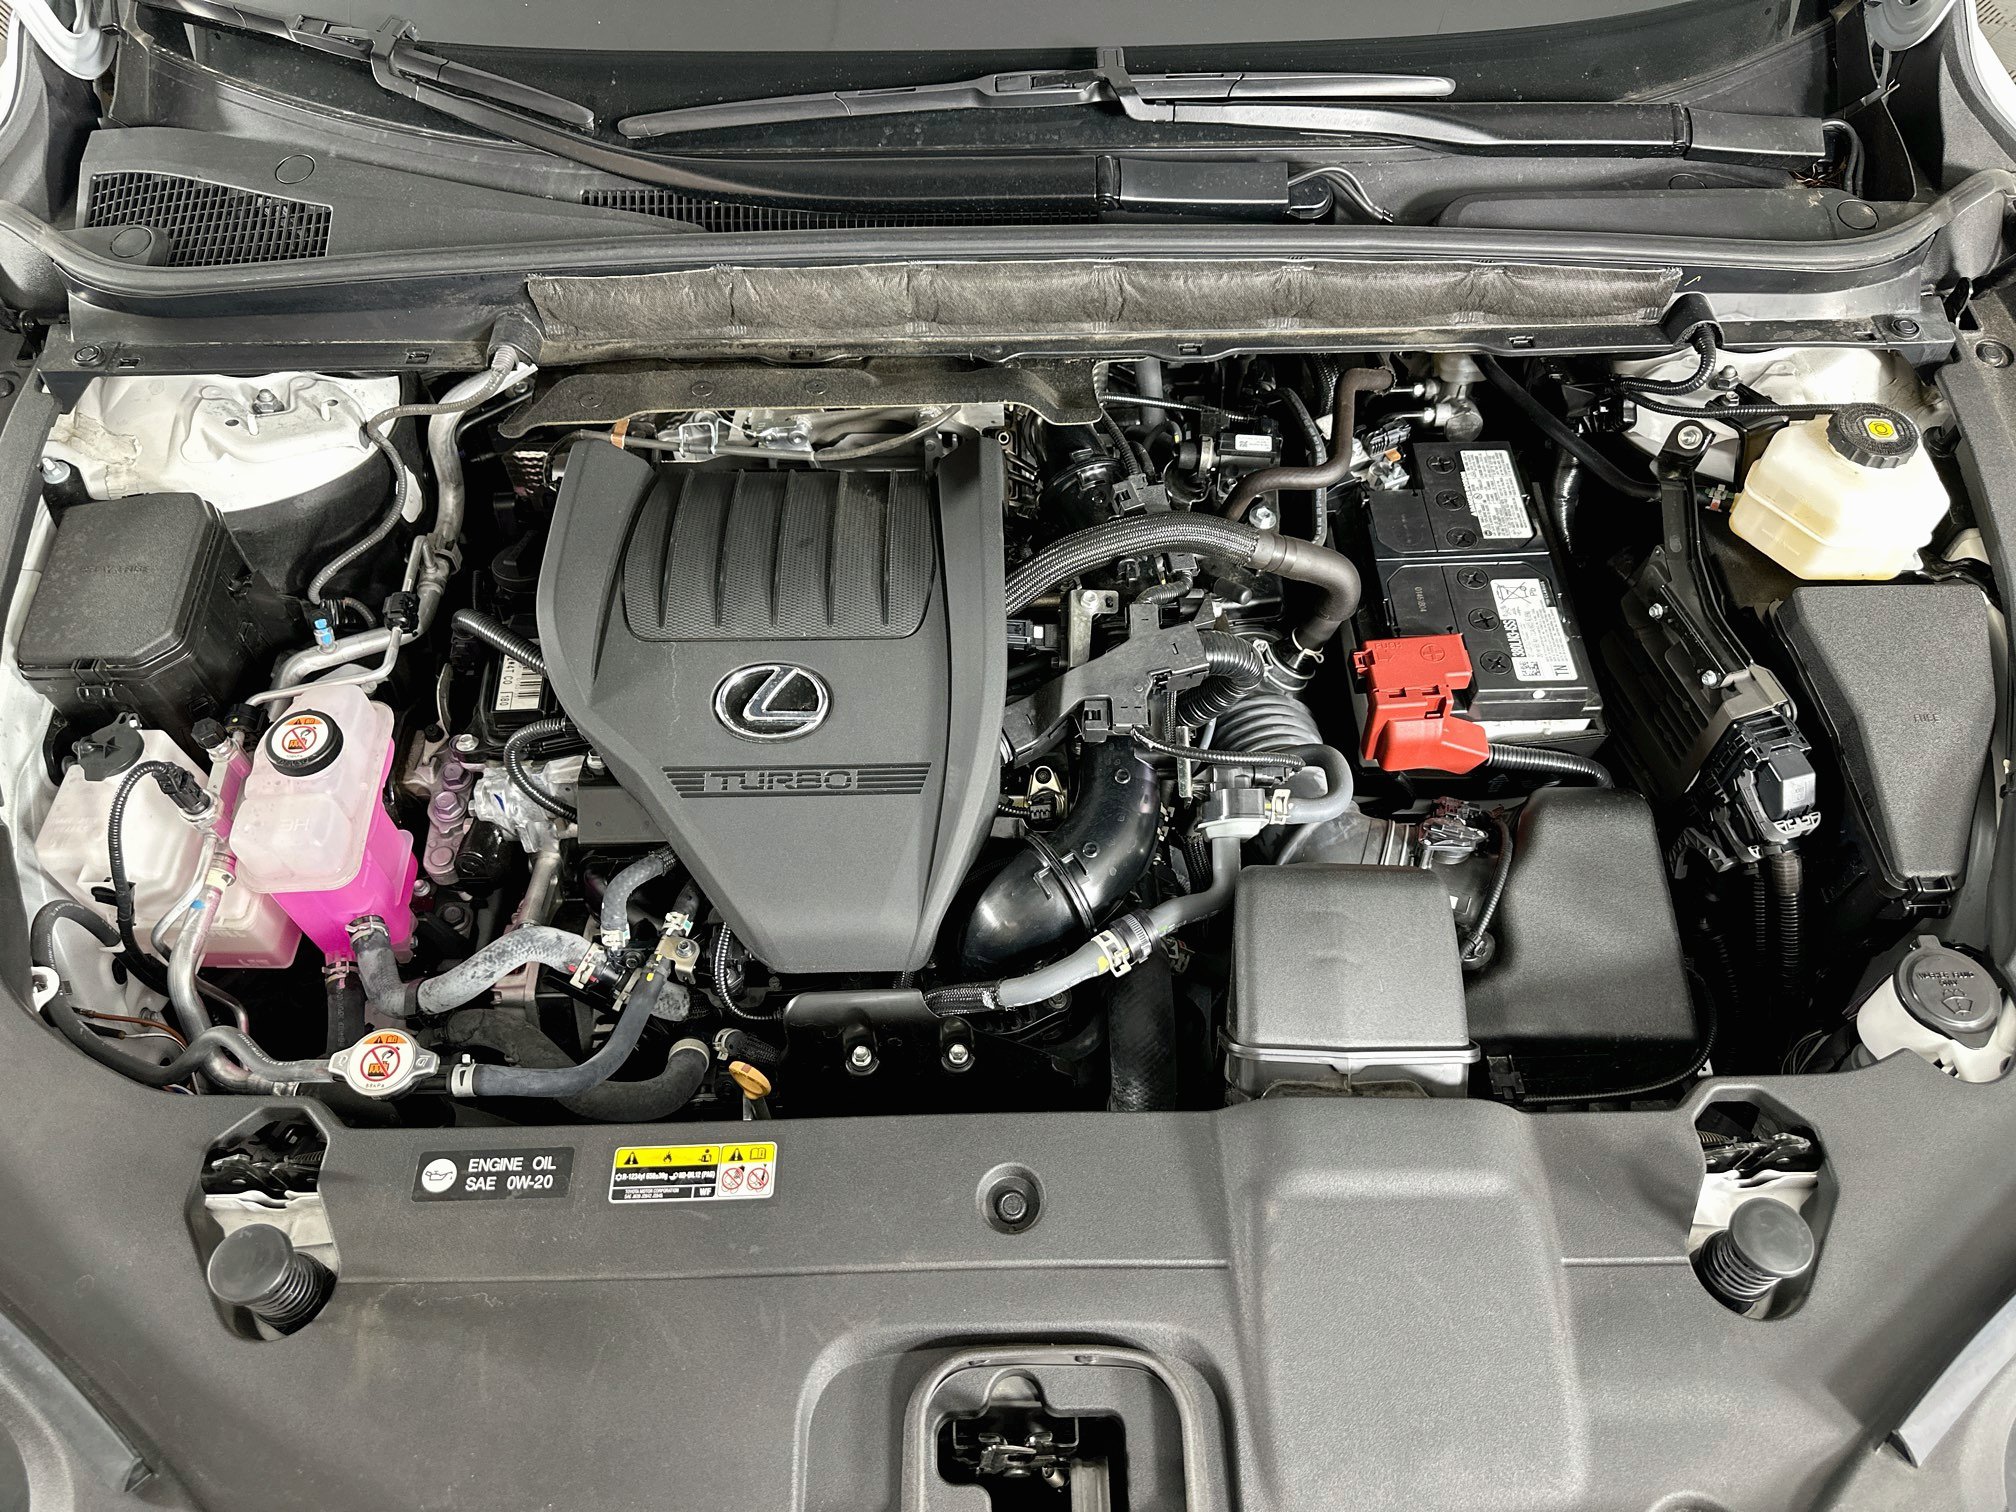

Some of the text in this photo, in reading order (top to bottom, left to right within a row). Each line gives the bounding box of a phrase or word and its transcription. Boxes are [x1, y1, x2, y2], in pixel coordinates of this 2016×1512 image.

[1530, 587, 1538, 597] Pb
[1553, 665, 1569, 677] TN
[710, 770, 852, 791] TURBO
[467, 1155, 557, 1173] ENGINE OIL
[464, 1174, 554, 1191] SAE 0W-20
[699, 1187, 712, 1197] WF
